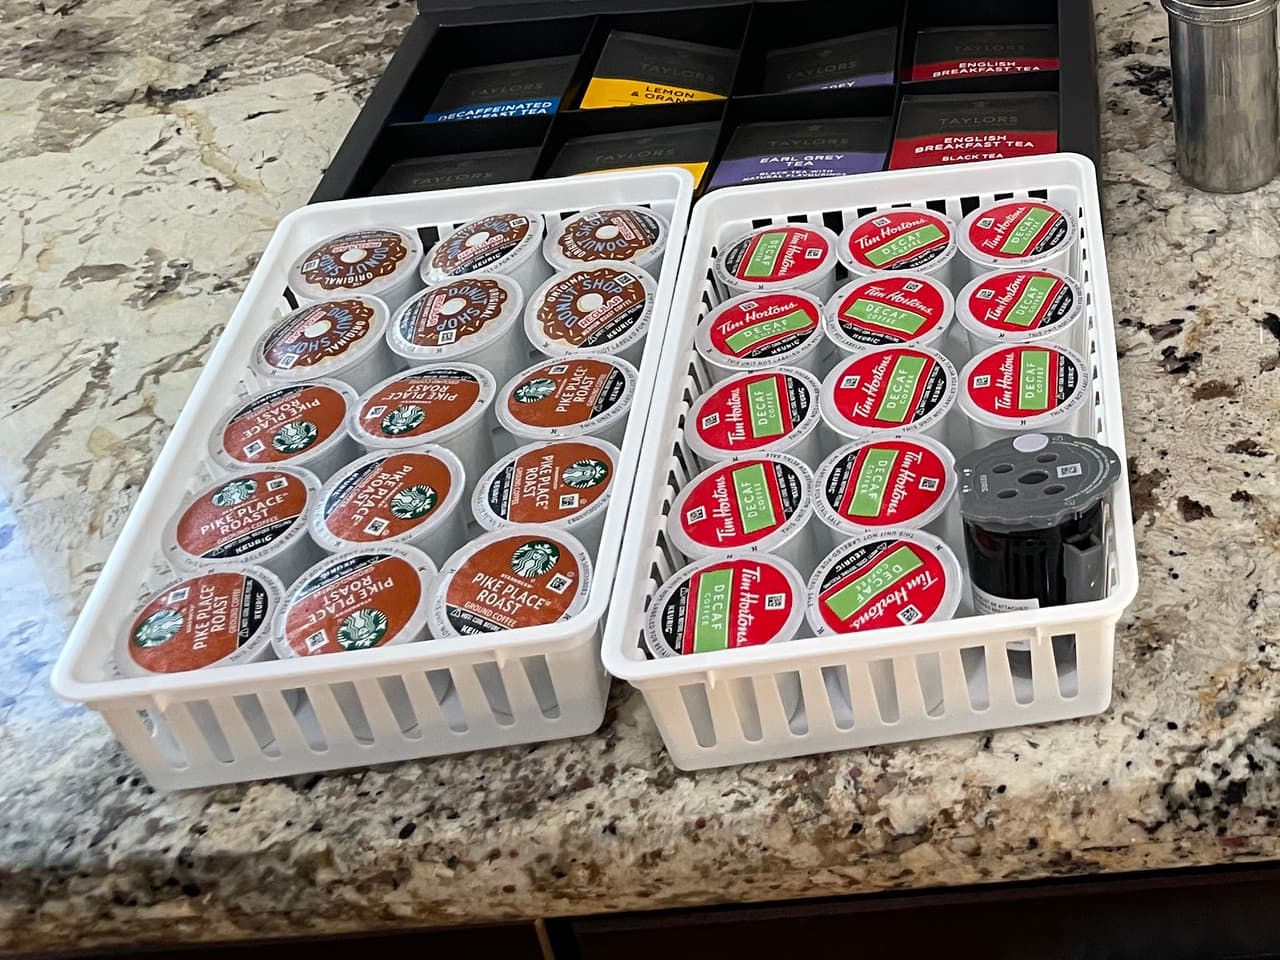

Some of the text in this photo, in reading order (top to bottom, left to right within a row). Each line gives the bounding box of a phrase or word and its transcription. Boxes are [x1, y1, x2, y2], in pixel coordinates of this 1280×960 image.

[932, 66, 1011, 79] BREAKFAST
[959, 61, 1017, 69] ENGLISH
[645, 85, 695, 99] LEMON
[437, 101, 553, 122] DECAFFEINATED
[520, 108, 547, 117] TEA
[914, 141, 1002, 154] BREAKFAST
[943, 135, 1008, 144] ENGLISH
[759, 154, 845, 164] EARL GREY
[941, 153, 979, 162] BLACK
[576, 238, 628, 253] DONUT
[790, 231, 809, 249] Tim
[854, 219, 929, 250] Tim Hortons
[881, 232, 922, 255] DECAF
[981, 235, 1002, 250] Tim
[1011, 217, 1036, 244] DECAF
[347, 246, 390, 277] DONUT
[761, 239, 780, 267] DECAF
[324, 271, 374, 286] ORIGINAL
[547, 273, 590, 303] ORIGINAL
[437, 285, 488, 332] DONUT SHOP
[556, 278, 623, 329] DONUT SHOP
[578, 295, 624, 329] REGULAR
[864, 285, 933, 316] Tim Hortons
[865, 303, 909, 320] DECAF
[984, 306, 1004, 321] Tim
[1015, 286, 1038, 316] DECAF
[606, 317, 635, 340] KEURIG
[717, 301, 799, 336] Tim Hortons
[743, 318, 789, 338] DECAF
[288, 336, 331, 354] SHOP
[324, 319, 366, 354] ORIGINAL
[770, 339, 801, 355] KEURIG
[407, 383, 451, 392] ROAST
[556, 367, 585, 413] PIKE PLACE
[573, 375, 597, 403] ROAST
[852, 354, 893, 418] Tim Hortons
[886, 368, 909, 409] DECAF
[994, 351, 1016, 411] Tim Hortons
[1024, 361, 1038, 399] DECAF
[386, 391, 459, 402] PIKE PLACE
[753, 390, 769, 426] DECAF
[247, 397, 321, 439] PIKE PLACE
[261, 399, 302, 426] ROAST
[724, 387, 747, 446] Tim Hortons
[350, 465, 414, 524] PIKE PLACE
[353, 473, 391, 506] ROAST
[522, 467, 540, 498] ROAST
[535, 455, 555, 508] PIKE PLACE
[867, 459, 889, 500] DECAF
[887, 450, 923, 516] Tim Hortons
[711, 474, 738, 543] Tim Hortons
[740, 481, 760, 519] DECAF
[200, 495, 285, 537] PIKE PLACE
[217, 516, 279, 545] GROUND COFFEE
[219, 508, 270, 536] ROAST
[235, 535, 273, 555] KEURIG
[832, 538, 862, 558] LABELED
[863, 532, 879, 542] NOT
[880, 529, 898, 538] UNIT
[898, 529, 915, 539] THIS
[835, 548, 868, 574] KEURIG
[322, 575, 374, 607] ROAST
[471, 573, 547, 611] PIKE PLACE
[854, 563, 890, 592] COFFEE
[856, 563, 904, 603] DECAF
[210, 595, 230, 634] ROAST
[308, 576, 395, 625] PIKE PLACE
[463, 602, 520, 628] GROUND COFFEE
[476, 591, 523, 616] ROAST
[701, 591, 713, 627] COFFEE
[711, 583, 726, 631] DECAF
[736, 565, 761, 647] Tim Hortons
[849, 570, 940, 630] Tim Hortons
[193, 584, 217, 651] PIKE PLACE
[664, 603, 676, 635] KEURIG
